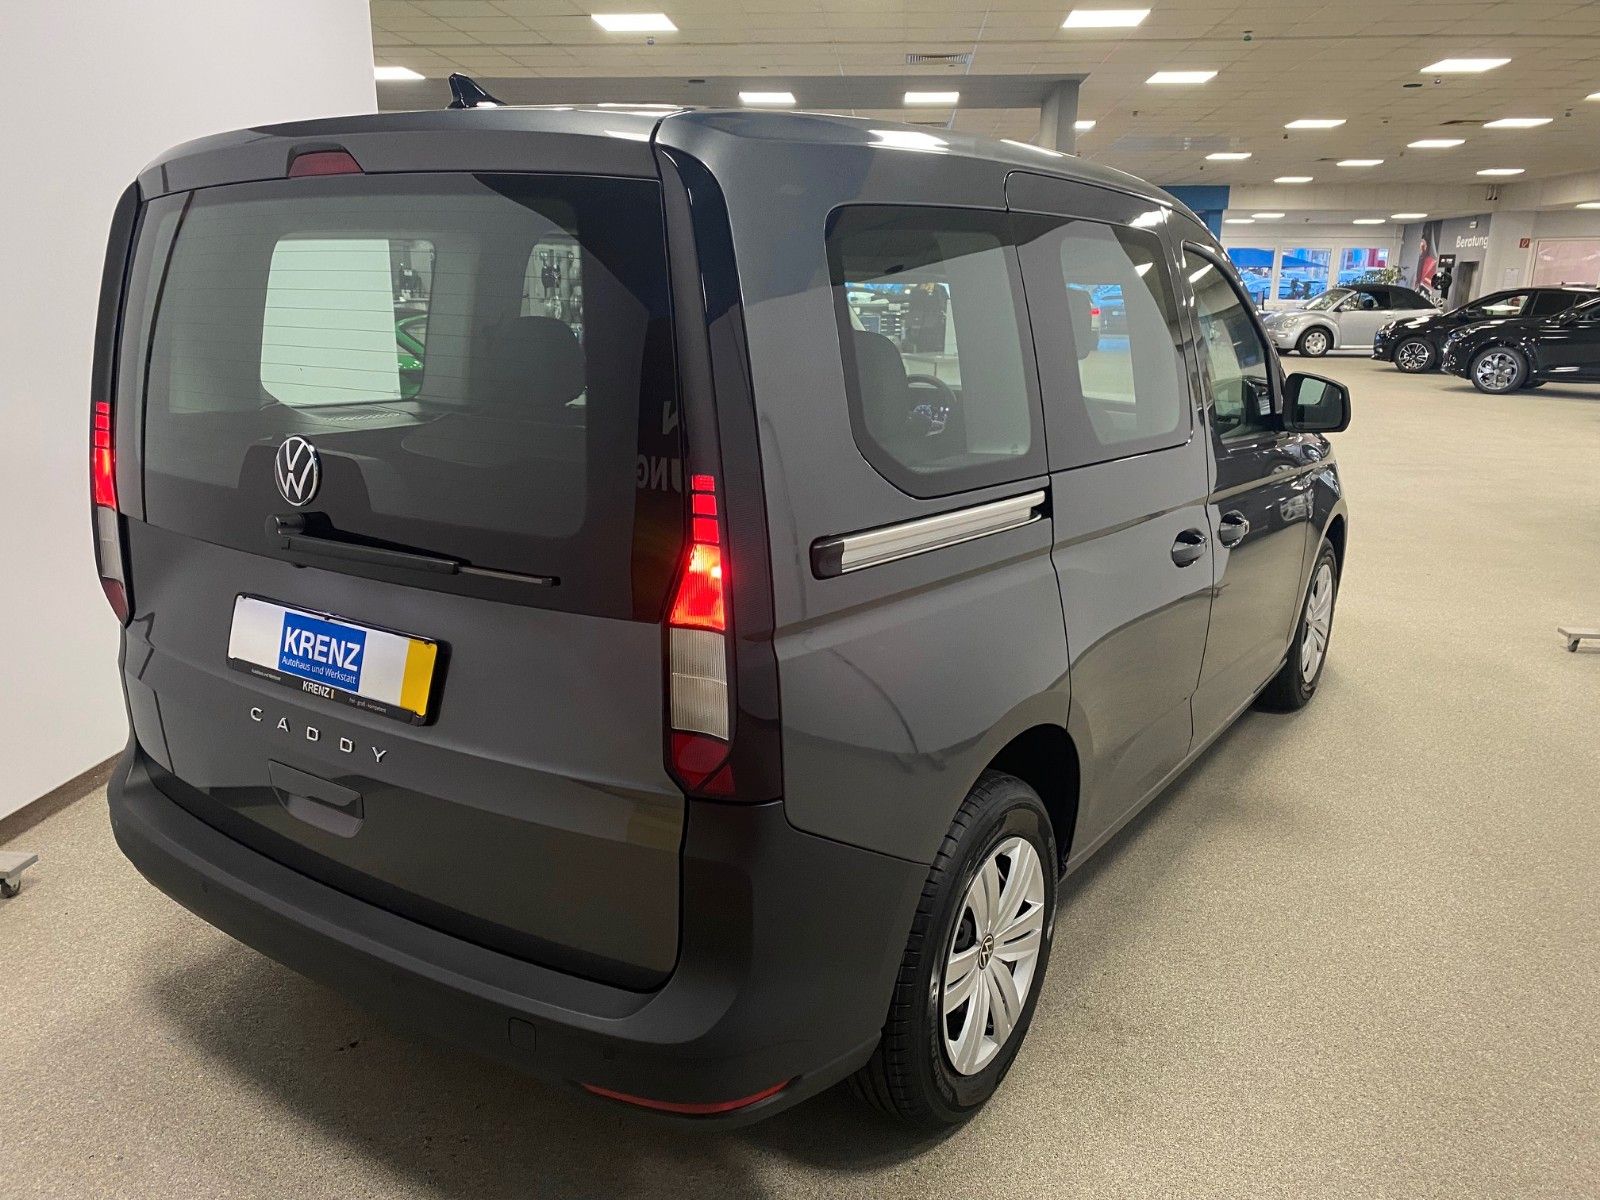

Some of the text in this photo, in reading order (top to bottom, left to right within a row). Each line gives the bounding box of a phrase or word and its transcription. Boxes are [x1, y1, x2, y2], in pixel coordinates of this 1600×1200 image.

[1456, 235, 1488, 248] Beratung
[284, 626, 360, 672] KRENZ
[281, 656, 356, 684] Autohaus und Werkstatt
[302, 680, 330, 697] KRENZ
[250, 707, 387, 763] CADDY
